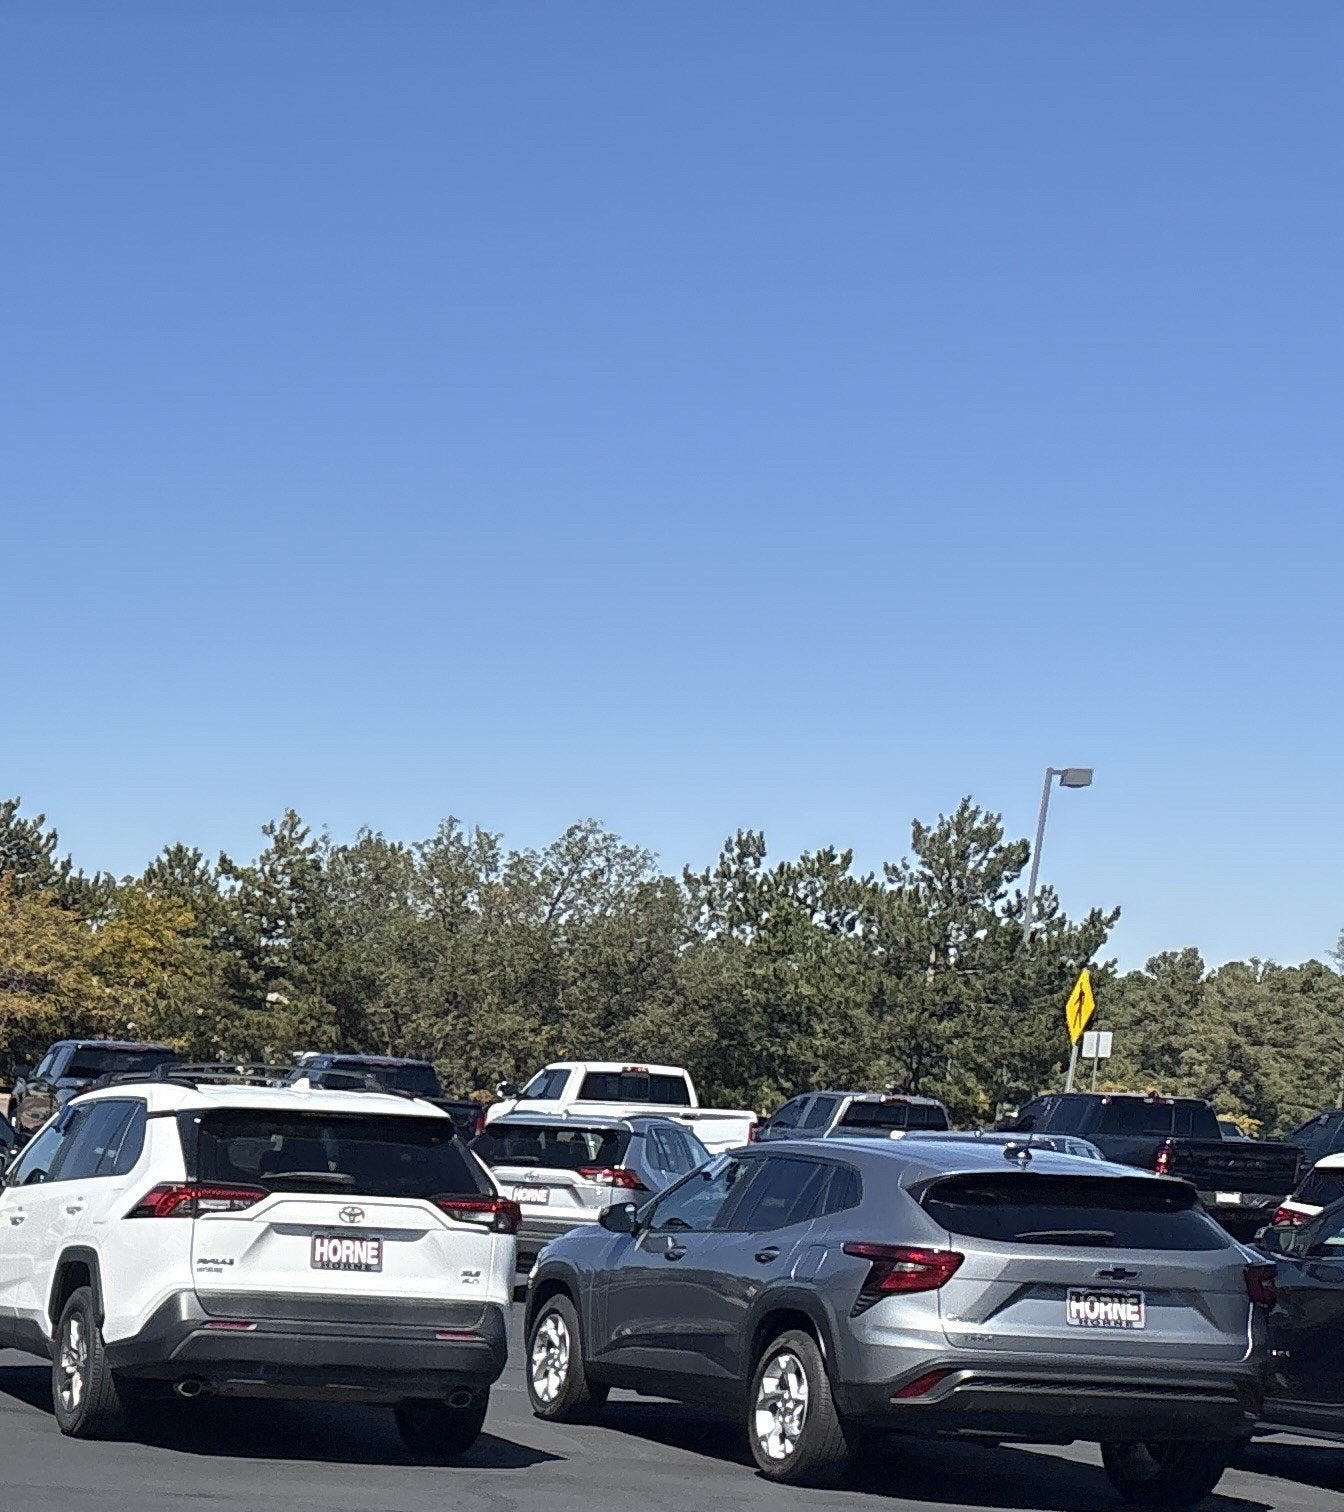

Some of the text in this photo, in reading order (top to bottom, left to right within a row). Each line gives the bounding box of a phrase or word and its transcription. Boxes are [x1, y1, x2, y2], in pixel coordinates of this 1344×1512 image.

[514, 1187, 548, 1203] HORNE
[315, 1238, 379, 1265] HORNE
[1070, 1295, 1140, 1321] HORNE
